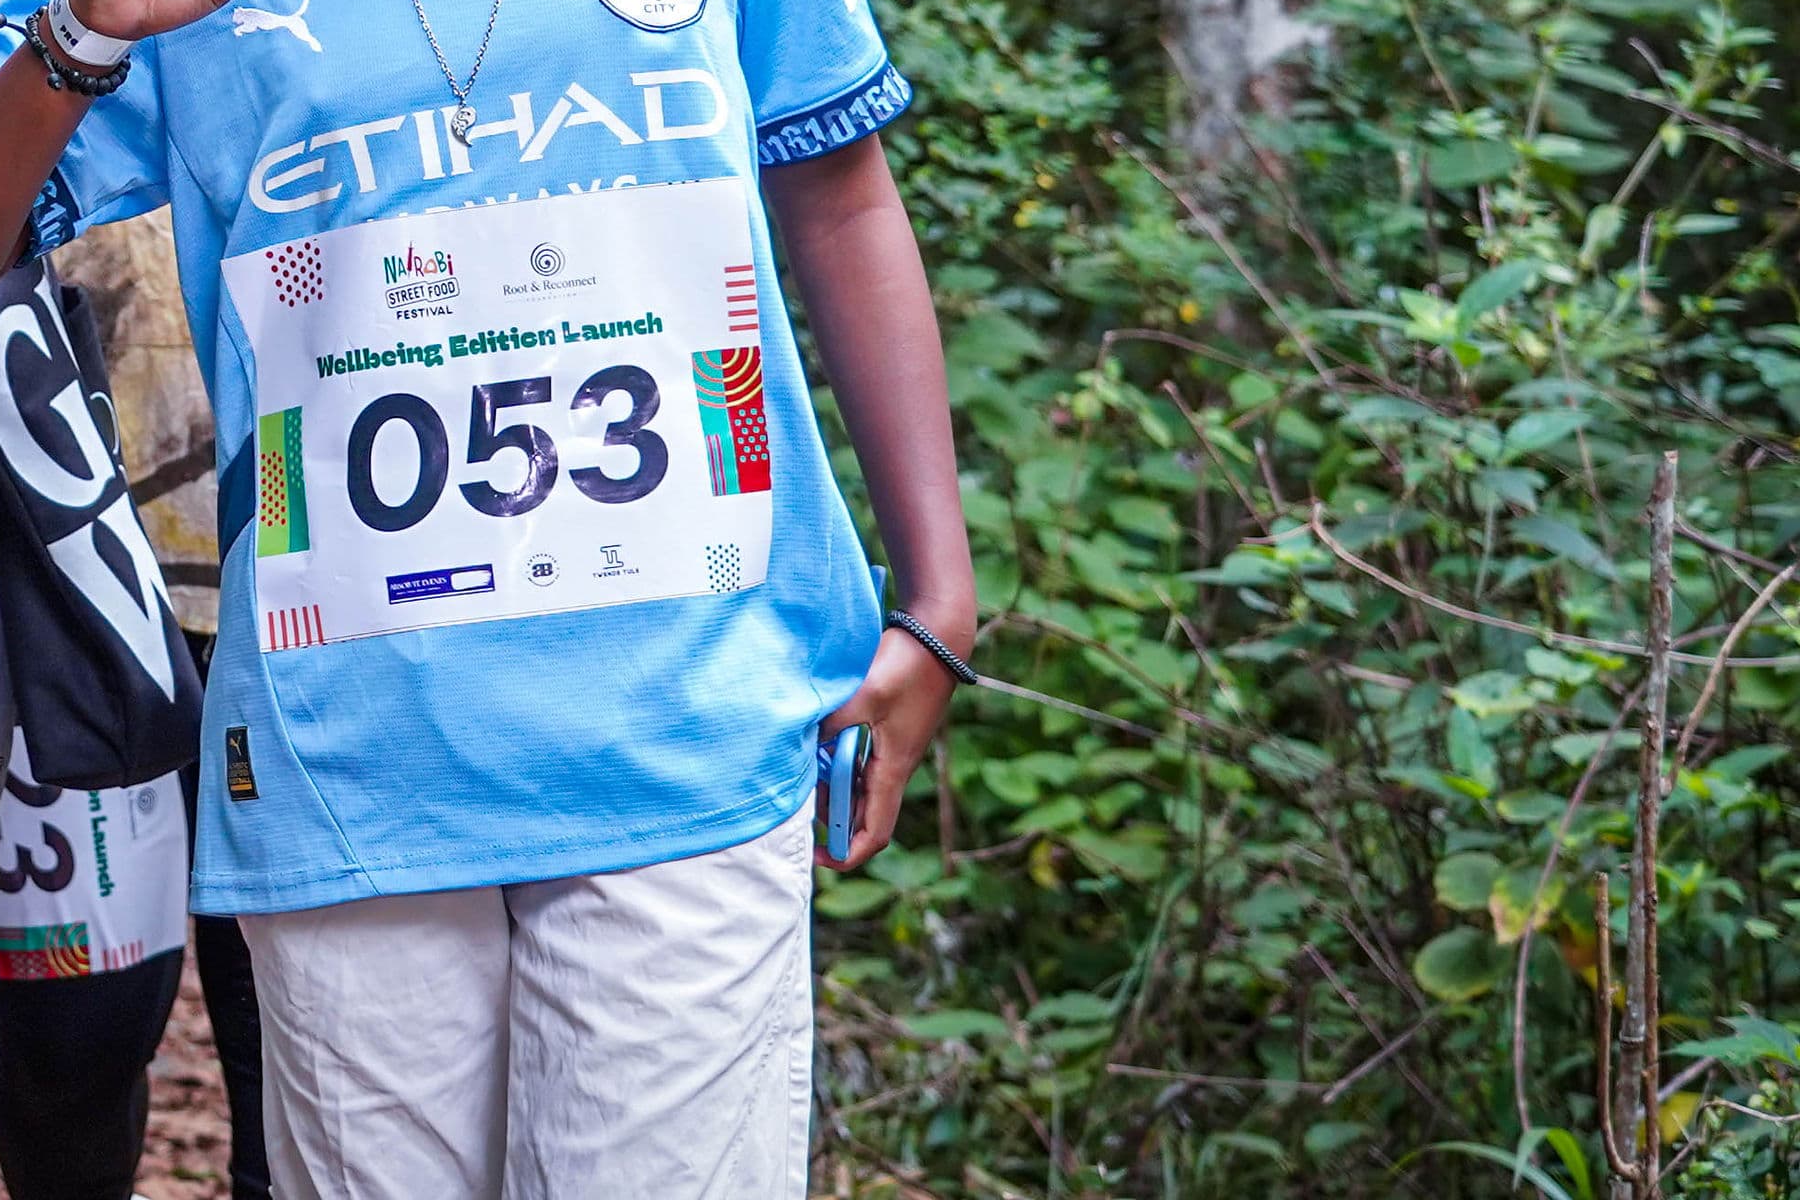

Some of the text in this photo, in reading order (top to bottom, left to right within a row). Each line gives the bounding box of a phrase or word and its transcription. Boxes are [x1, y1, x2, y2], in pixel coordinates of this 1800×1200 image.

[644, 3, 676, 14] CITY
[249, 69, 725, 213] ETIHAD
[388, 281, 456, 305] STREET FOOD
[503, 275, 597, 296] Root & Reconnect
[396, 305, 454, 320] FESTIVAL
[316, 311, 663, 379] Wellbeing Edition Launch
[347, 364, 669, 533] 053
[91, 815, 115, 897] Launch
